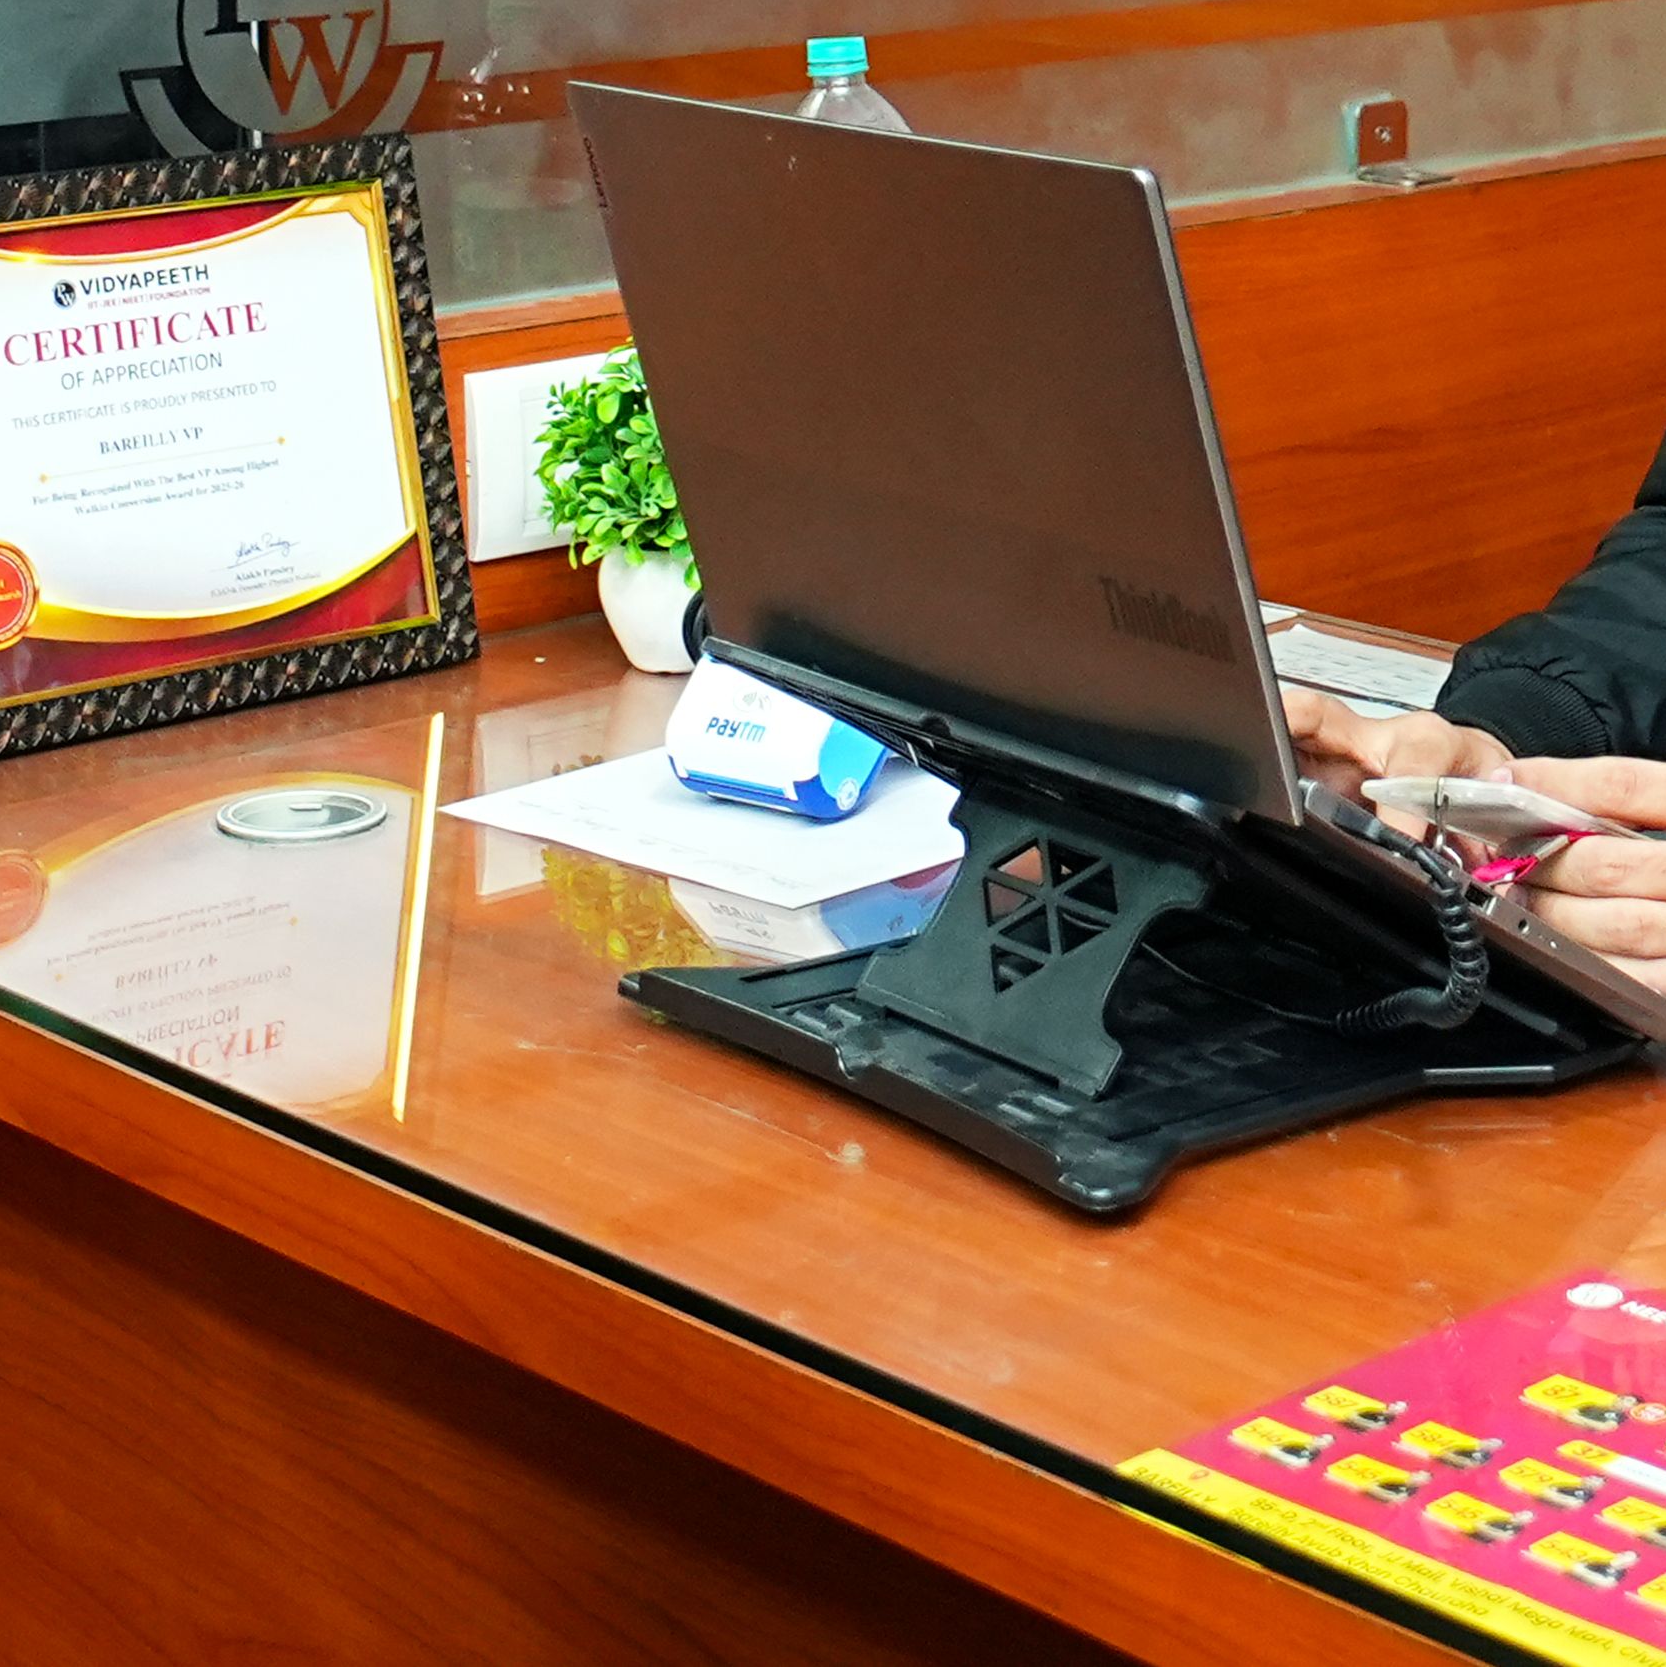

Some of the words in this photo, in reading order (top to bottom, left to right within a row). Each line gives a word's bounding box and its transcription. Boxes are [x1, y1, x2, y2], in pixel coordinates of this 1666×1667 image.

[80, 264, 210, 296] VIDYAPEETH
[3, 301, 268, 367] CERTIFICATE
[61, 371, 85, 391] OF
[92, 351, 223, 386] APPRECIATION
[12, 415, 41, 430] THIS
[43, 403, 116, 426] CERTIFICATE
[121, 401, 132, 414] IS
[134, 394, 188, 411] PROUDLY
[191, 383, 259, 403] PRESENTED
[260, 380, 277, 393] TO
[100, 429, 179, 455] BAREILLY
[182, 426, 204, 440] VP
[1099, 575, 1237, 664] ThinkBook
[1541, 1383, 1581, 1403] 87
[1505, 1600, 1565, 1631] Mega
